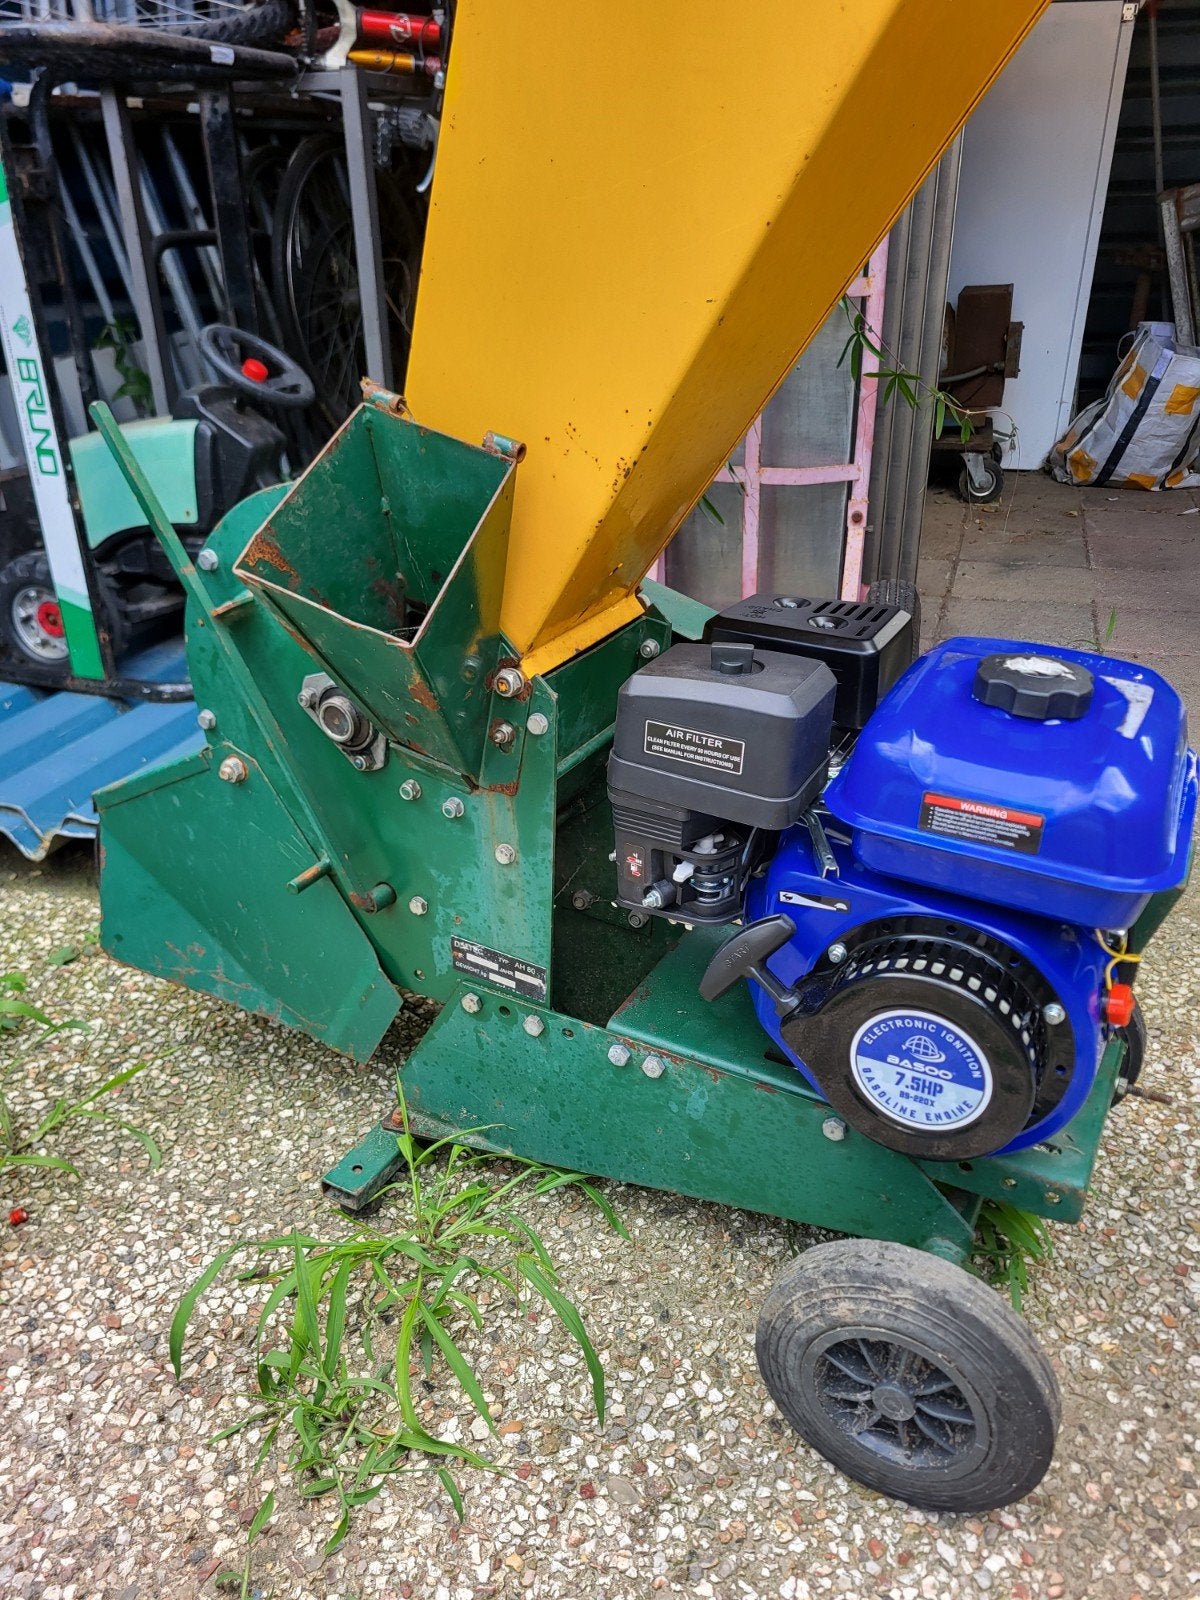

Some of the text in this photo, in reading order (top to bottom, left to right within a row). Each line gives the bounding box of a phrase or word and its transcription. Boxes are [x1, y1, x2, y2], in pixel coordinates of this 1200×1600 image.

[17, 358, 59, 476] BRUNO
[647, 736, 663, 745] CLEAN
[663, 739, 681, 749] FILTER
[680, 743, 698, 752] EVERY
[703, 749, 722, 758] HOURS
[729, 755, 741, 763] USE
[665, 728, 723, 749] AIR FILTER
[663, 747, 684, 757] MANUAL
[683, 752, 695, 760] FOR
[694, 755, 734, 770] INSTRUCTIONS)
[960, 802, 1008, 820] WARNING
[455, 960, 480, 975] GEWICHT
[514, 961, 526, 972] AH
[862, 1018, 982, 1079] ELECTRONIC IGNITION
[862, 1066, 974, 1122] GASOLINE ENGINE
[894, 1071, 944, 1098] 7.5HP
